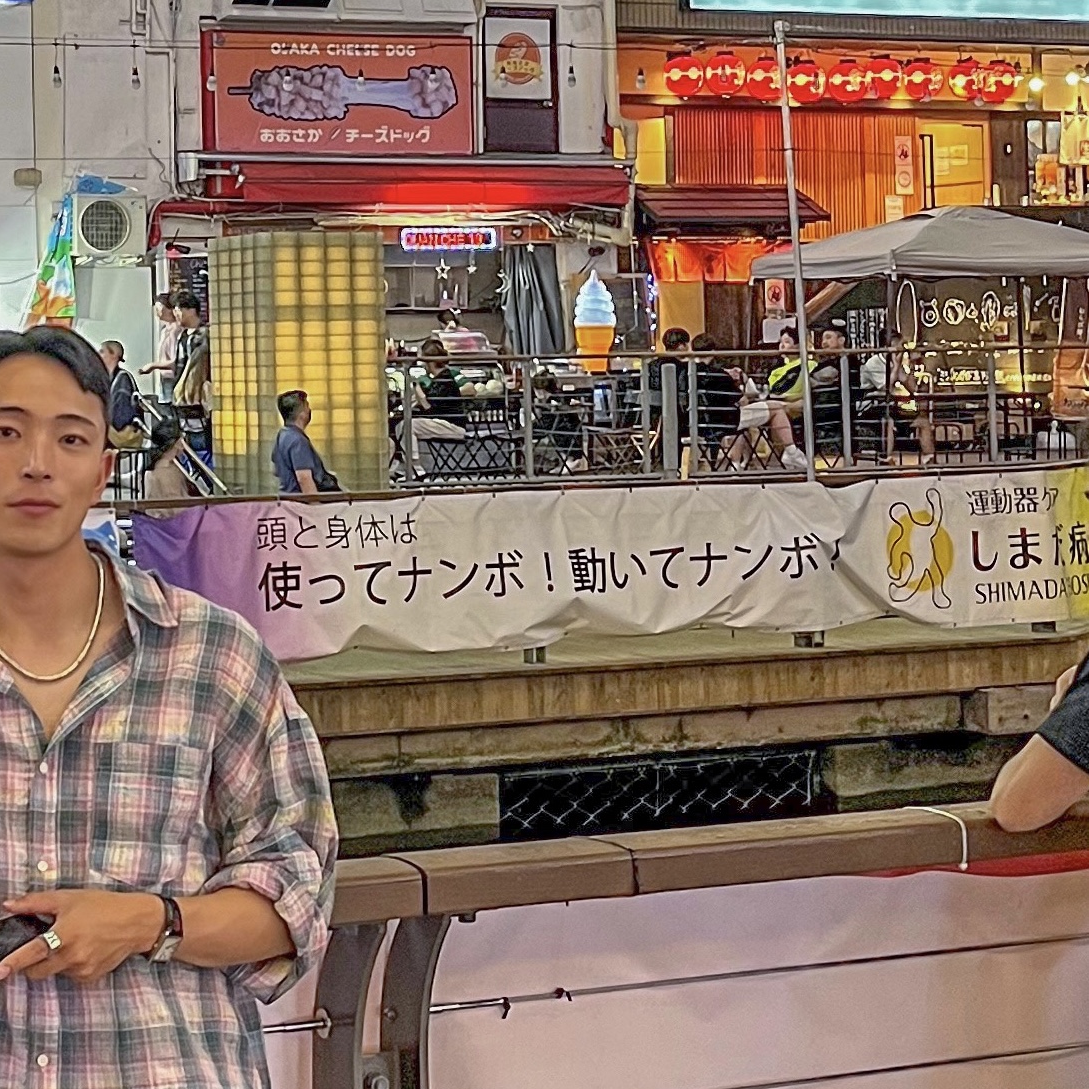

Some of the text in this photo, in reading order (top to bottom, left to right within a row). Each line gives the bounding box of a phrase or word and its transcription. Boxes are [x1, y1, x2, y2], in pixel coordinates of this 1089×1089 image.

[270, 42, 417, 57] OSAKA CHEESE DOG
[260, 127, 324, 143] おおさか
[345, 125, 431, 143] チーズドッグ
[256, 513, 418, 552] 頭と身体は
